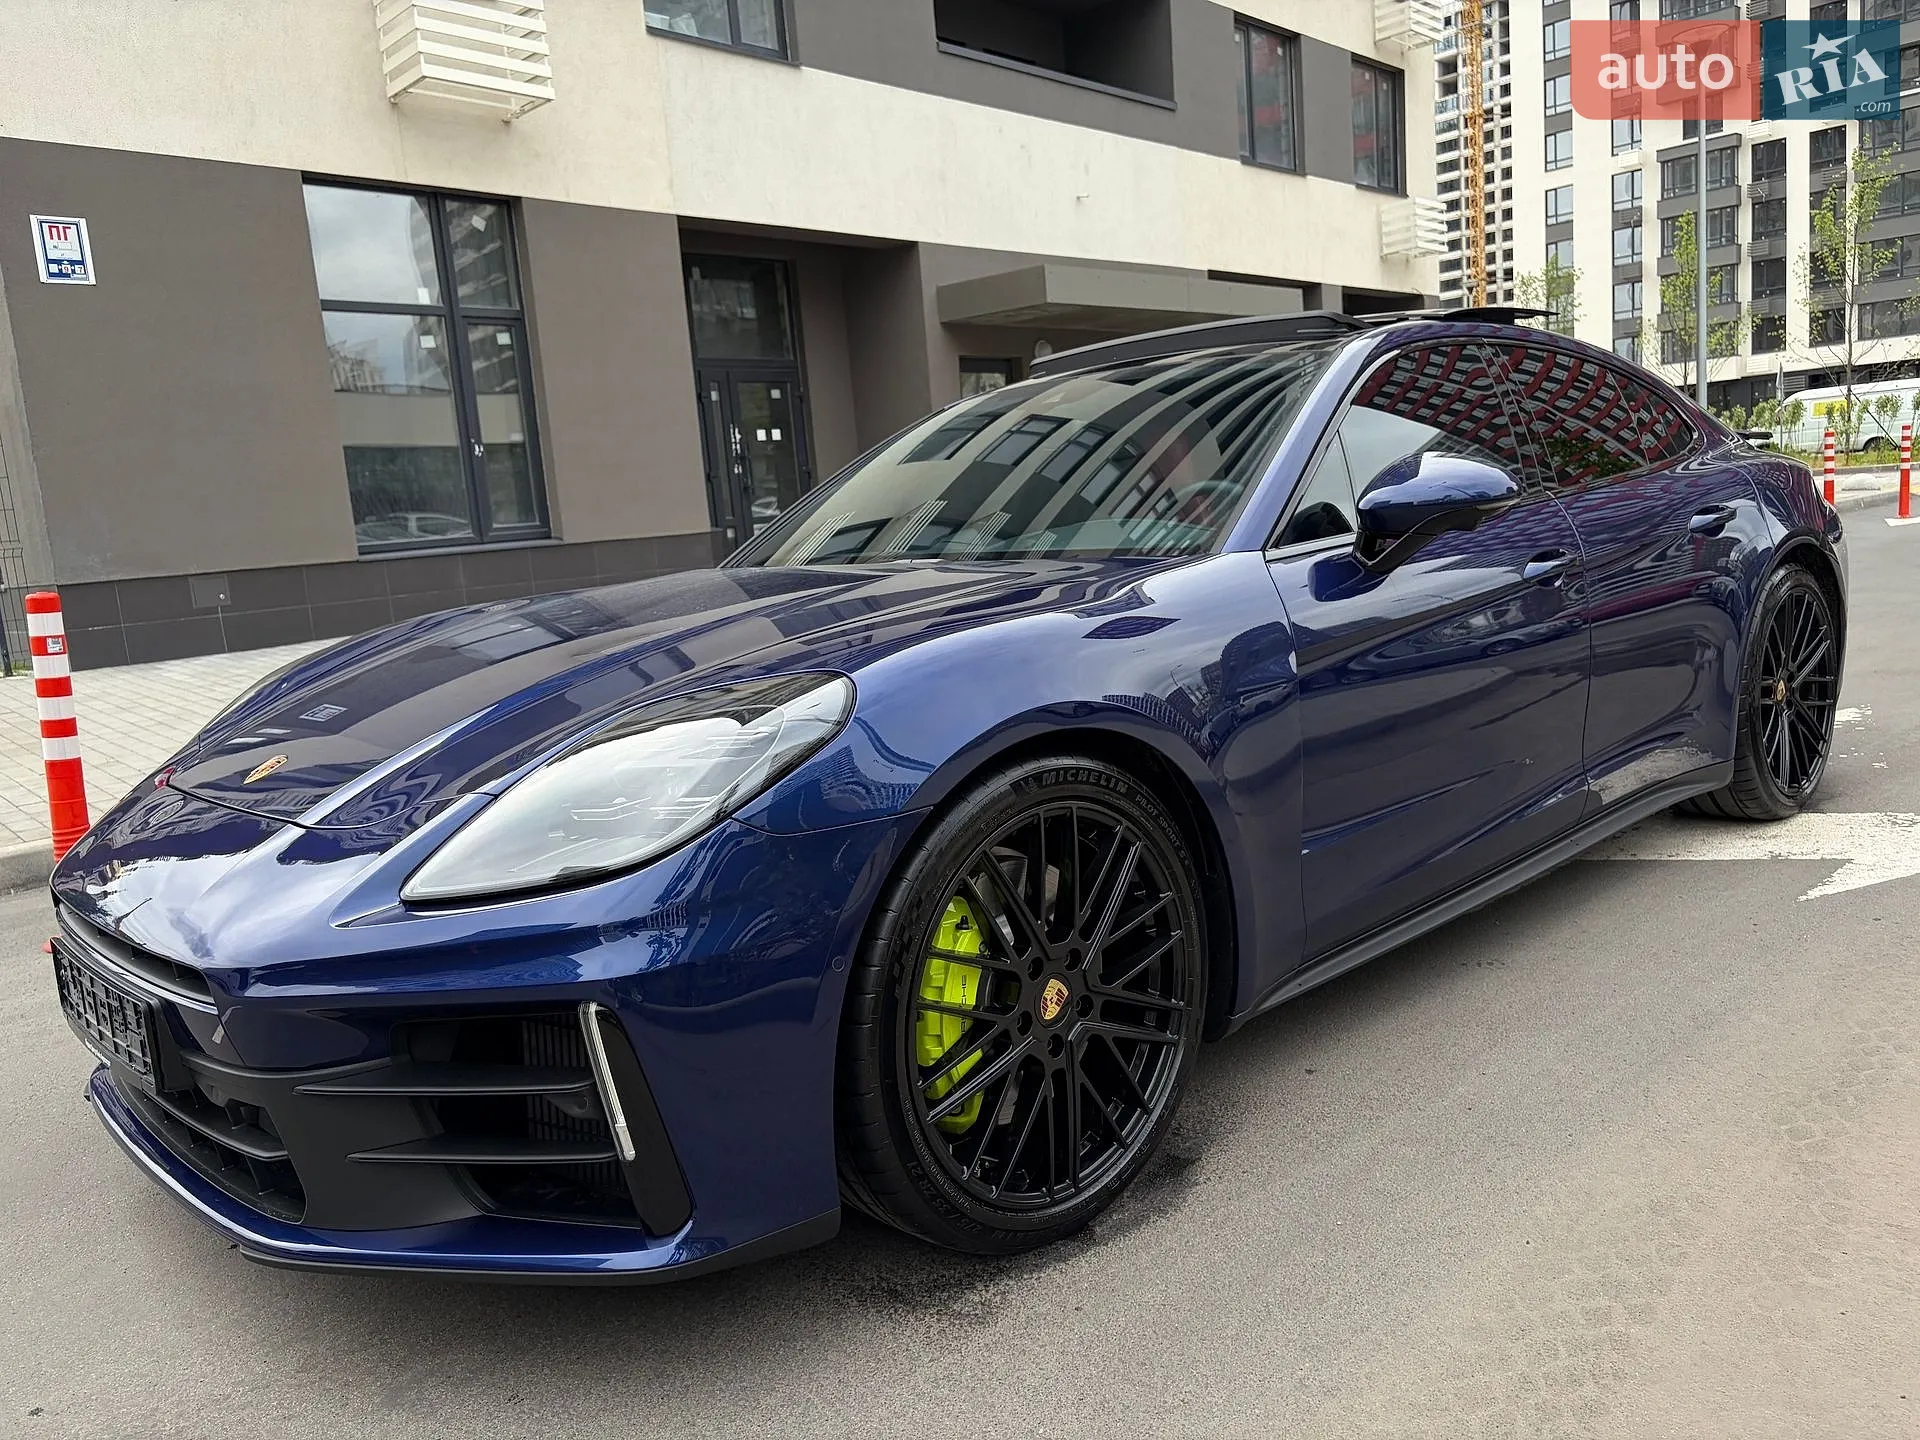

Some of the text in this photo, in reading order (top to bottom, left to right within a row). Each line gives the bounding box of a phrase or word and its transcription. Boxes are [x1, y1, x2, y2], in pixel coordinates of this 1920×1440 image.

[48, 225, 71, 241] ПГ
[1042, 769, 1128, 793] MICHELIN
[1135, 794, 1159, 817] PILOT
[1156, 816, 1181, 848] SPORT
